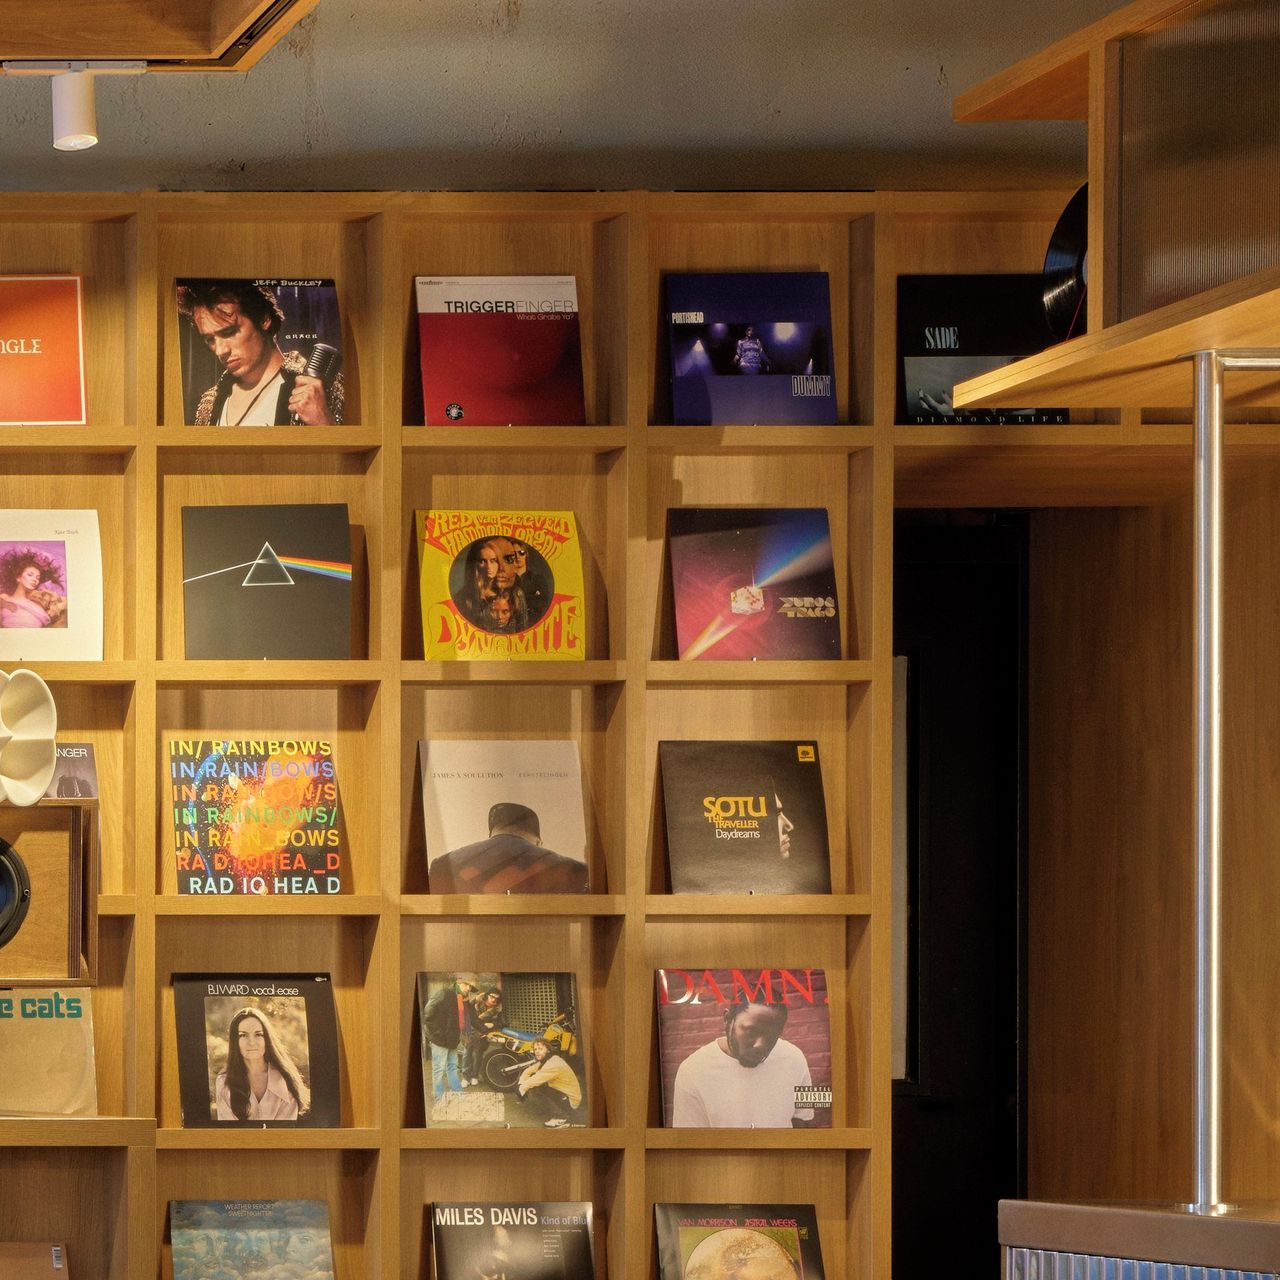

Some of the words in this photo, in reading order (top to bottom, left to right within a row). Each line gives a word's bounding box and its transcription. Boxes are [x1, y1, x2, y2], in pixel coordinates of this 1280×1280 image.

[925, 326, 959, 349] SADE
[791, 375, 831, 396] DUMMY
[1018, 415, 1063, 423] LIFE
[212, 741, 332, 756] RAINBOWS
[172, 762, 195, 779] IN
[174, 784, 197, 801] IN
[703, 796, 768, 818] SOTU
[715, 820, 760, 829] TRAVELLER
[176, 831, 199, 847] IN
[715, 829, 761, 841] Daydreams
[190, 877, 234, 895] RAD
[657, 968, 829, 1006] DAMN.
[20, 991, 83, 1019] cats
[795, 1092, 832, 1102] ADVISORY
[436, 1207, 485, 1226] MILES
[490, 1207, 538, 1226] DAVIS
[541, 1215, 560, 1226] Kind
[561, 1215, 572, 1226] of
[771, 1218, 798, 1227] WEEKS
